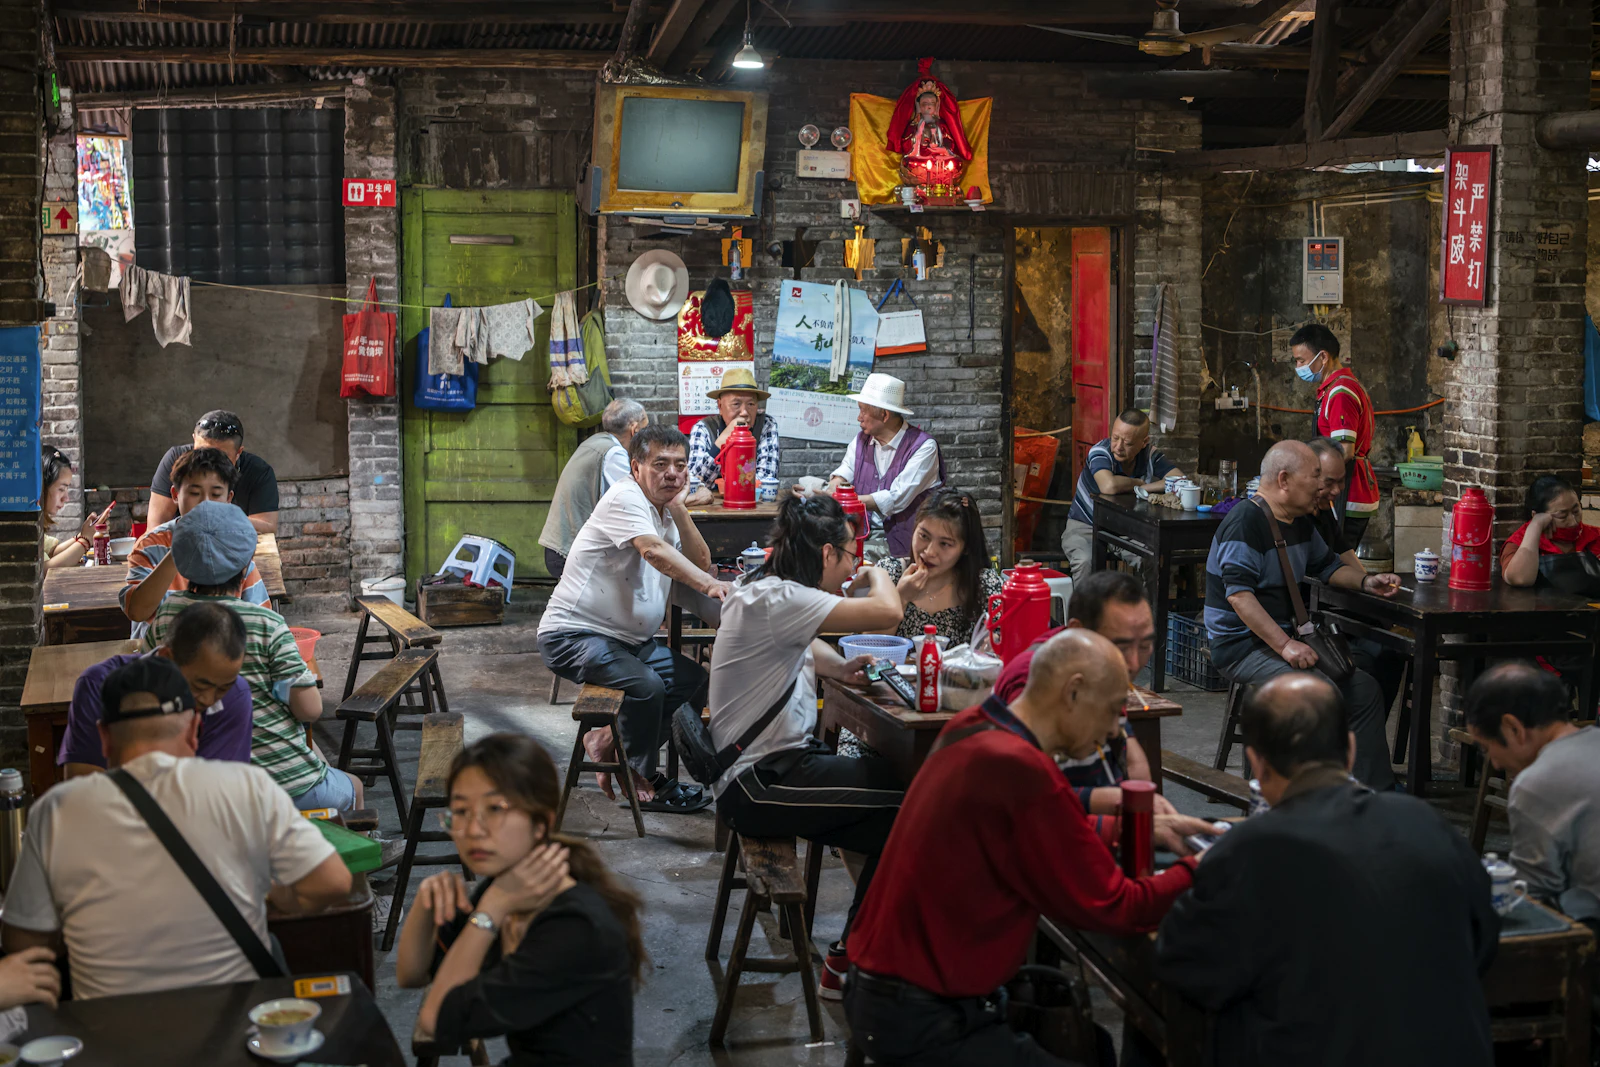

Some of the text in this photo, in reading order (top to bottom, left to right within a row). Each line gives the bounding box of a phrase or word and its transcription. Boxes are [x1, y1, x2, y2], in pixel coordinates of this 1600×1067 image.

[366, 183, 392, 193] 卫生间
[1450, 160, 1469, 265] 架斗殴
[1467, 183, 1485, 290] 严禁打
[796, 315, 834, 329] 人不负青
[810, 333, 866, 351] 青山负人
[924, 653, 936, 696] 天府可乐
